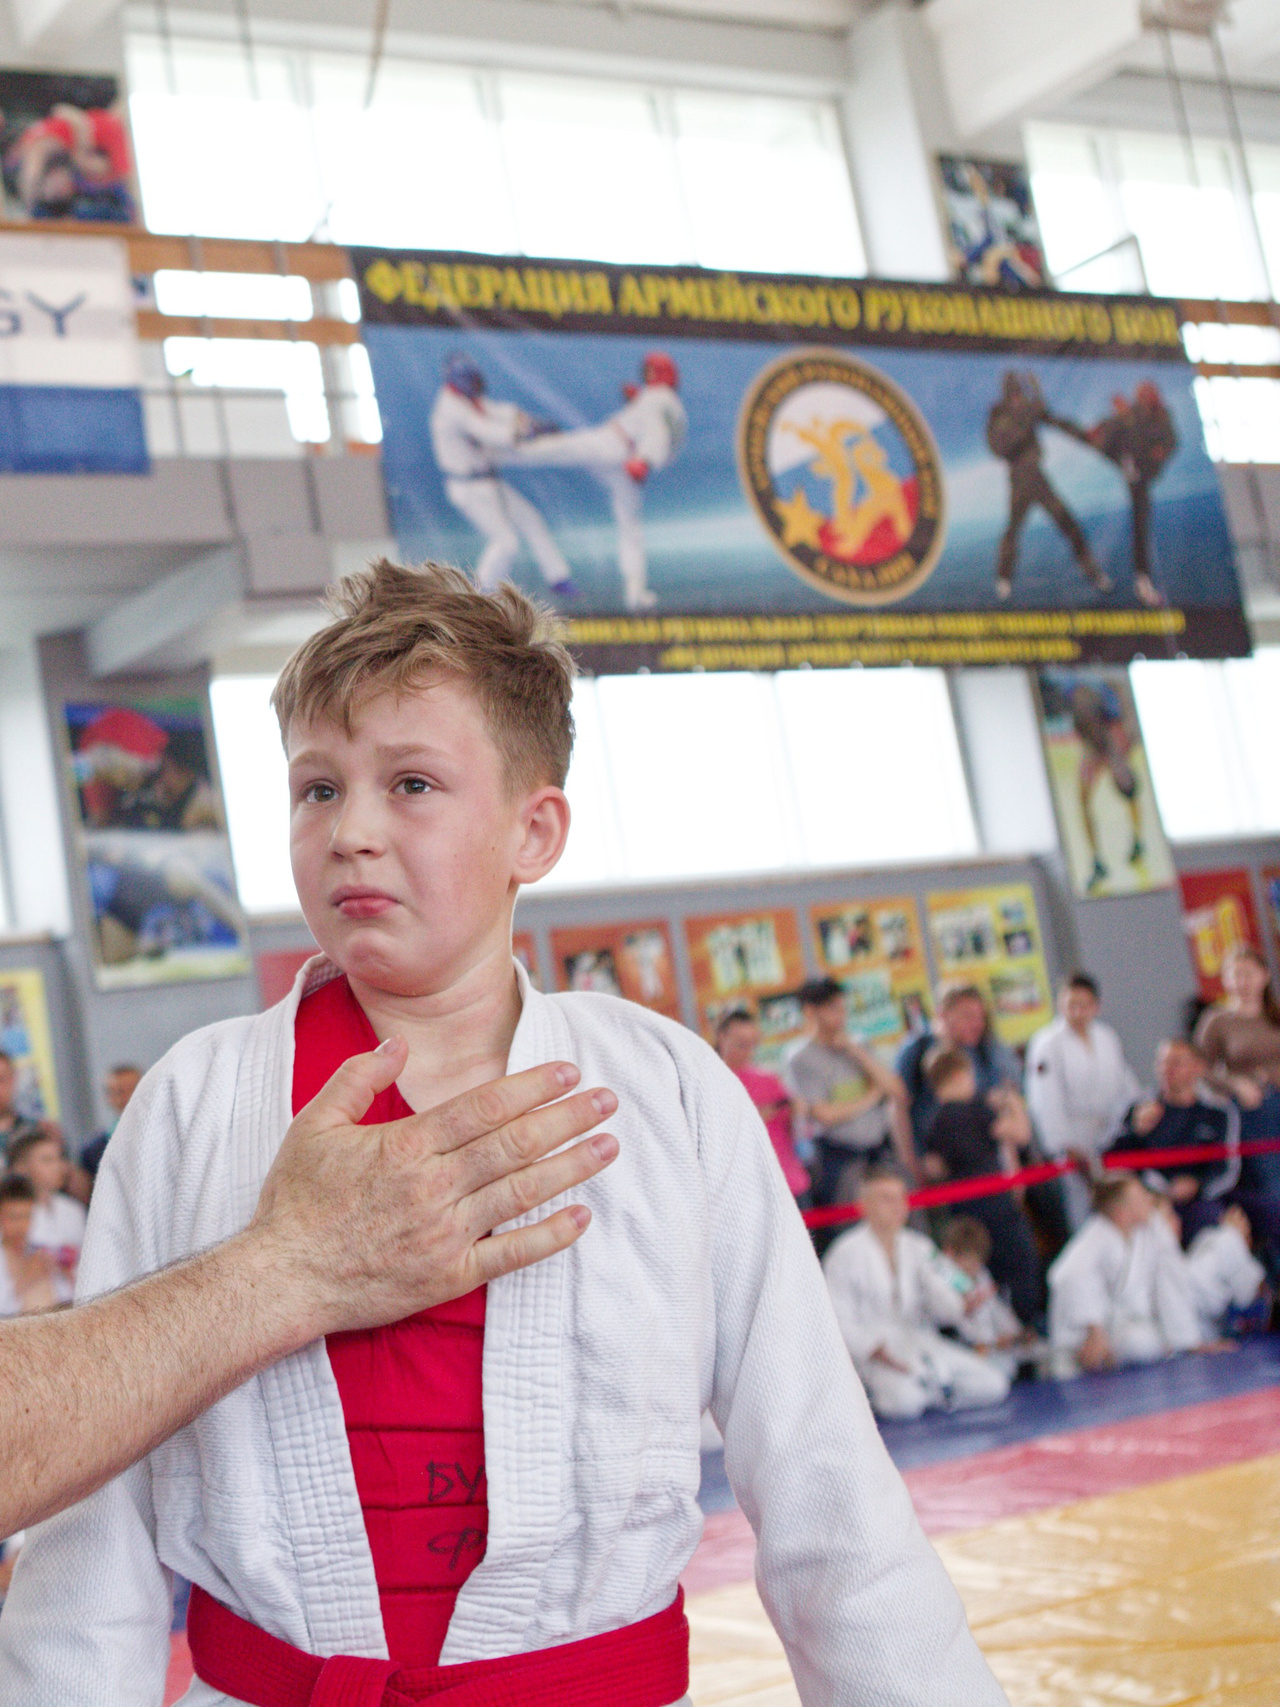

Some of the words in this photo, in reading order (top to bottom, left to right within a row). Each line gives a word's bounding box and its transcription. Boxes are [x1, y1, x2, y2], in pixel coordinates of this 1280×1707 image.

[365, 258, 614, 320] ФЕДЕРАЦИЯ
[620, 273, 861, 330] АРМЕЙСКОГО
[863, 285, 1112, 344] РУКОПАШНОГО
[1114, 304, 1179, 347] БОЯ
